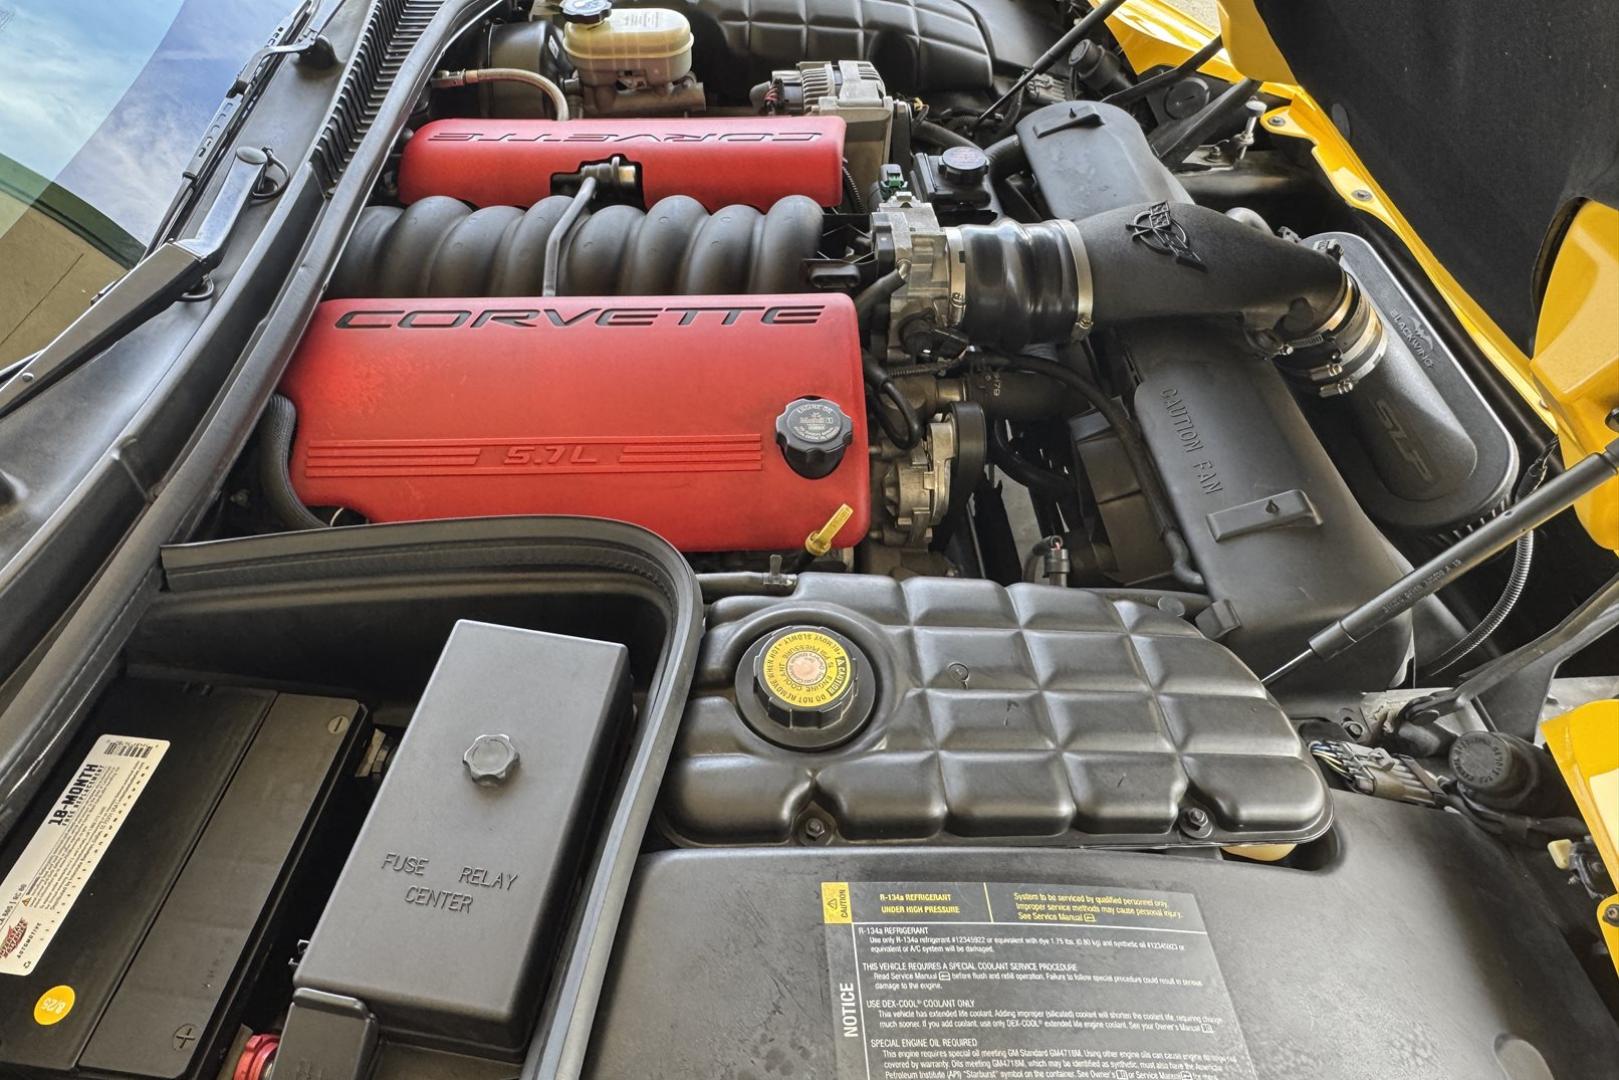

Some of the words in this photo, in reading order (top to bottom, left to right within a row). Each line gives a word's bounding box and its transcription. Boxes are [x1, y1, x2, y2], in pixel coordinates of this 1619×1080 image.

[428, 132, 822, 142] CORVETTE
[335, 305, 825, 329] CORVETTE
[1390, 308, 1434, 369] BLACKWING
[1159, 387, 1205, 454] CAUTION
[1193, 459, 1224, 496] FAN
[503, 444, 598, 465] 5.7L
[784, 634, 811, 645] SLOWLY
[771, 646, 780, 658] HOT
[767, 659, 775, 678] WHEN
[779, 663, 802, 691] COOLANT
[830, 666, 846, 693] CAUTION
[806, 675, 832, 692] ENGINE
[771, 679, 797, 701] REMOVE
[816, 694, 826, 702] DO
[48, 764, 98, 826] 18-MONTH
[61, 811, 75, 826] FREE
[73, 765, 104, 808] REPLACEMENT
[381, 852, 430, 876] FUSE
[459, 866, 518, 891] RELAY
[404, 885, 474, 914] CENTER
[905, 893, 951, 901] REFRIGERANT
[1014, 892, 1038, 902] System
[1086, 896, 1094, 904] by
[1095, 896, 1123, 904] qualified
[881, 905, 904, 913] UNDER
[906, 905, 924, 913] HIGH
[925, 905, 960, 913] PRESSURE
[1016, 903, 1046, 911] Improper
[1101, 907, 1115, 915] may
[1018, 912, 1032, 920] See
[1032, 912, 1058, 920] Service
[17, 922, 41, 959] AUTOMOTIVE
[882, 936, 895, 944] only
[871, 945, 901, 953] equivalent
[922, 945, 944, 953] system
[863, 962, 878, 971] THIS
[879, 962, 908, 970] VEHICLE
[908, 962, 942, 970] REQUIRES
[949, 962, 976, 970] SPECIAL
[977, 962, 1008, 970] COOLANT
[1010, 962, 1039, 970] SERVICE
[1039, 963, 1077, 971] PROCEDURE
[874, 972, 889, 980] Read
[890, 972, 913, 980] Service
[914, 972, 937, 980] Manual
[951, 972, 971, 980] before
[875, 982, 900, 991] damage
[901, 982, 908, 990] to
[866, 999, 880, 1008] USE
[923, 999, 956, 1007] COOLANT
[957, 999, 975, 1008] ONLY
[839, 983, 858, 1038] NOTICE
[879, 1010, 892, 1018] This
[893, 1010, 915, 1018] vehicle
[916, 1010, 928, 1018] has
[928, 1010, 957, 1018] extended
[958, 1010, 968, 1018] life
[995, 1009, 1016, 1019] Adding
[1017, 1011, 1044, 1019] improper
[880, 1020, 897, 1028] much
[928, 1021, 940, 1030] you
[941, 1020, 953, 1028] add
[992, 1021, 1005, 1029] only
[1044, 1020, 1072, 1028] extended
[1073, 1020, 1083, 1028] life
[1084, 1021, 1104, 1030] engine
[1128, 1021, 1141, 1030] See
[1141, 1023, 1154, 1032] your
[871, 1038, 900, 1048] SPECIAL
[902, 1038, 928, 1048] ENGINE
[929, 1038, 941, 1047] OIL
[942, 1038, 978, 1047] REQUIRED
[883, 1049, 897, 1058] This
[898, 1050, 919, 1060] engine
[921, 1050, 948, 1059] requires
[948, 1049, 971, 1058] special
[981, 1049, 1007, 1058] meeting
[1007, 1048, 1019, 1057] GM
[1020, 1048, 1048, 1058] Standard
[1083, 1049, 1102, 1059] Using
[1102, 1050, 1118, 1058] other
[1119, 1051, 1140, 1060] engine
[884, 1061, 909, 1069] covered
[910, 1060, 919, 1070] by
[950, 1059, 964, 1068] Oils
[965, 1060, 990, 1070] meeting
[1028, 1060, 1048, 1068] which
[1048, 1061, 1062, 1070] may
[885, 1071, 918, 1080] Petroleum
[919, 1071, 945, 1080] Institute
[1000, 1071, 1024, 1080] symbol
[1033, 1070, 1044, 1078] the
[1077, 1069, 1089, 1078] See
[1135, 1071, 1158, 1080] Service
